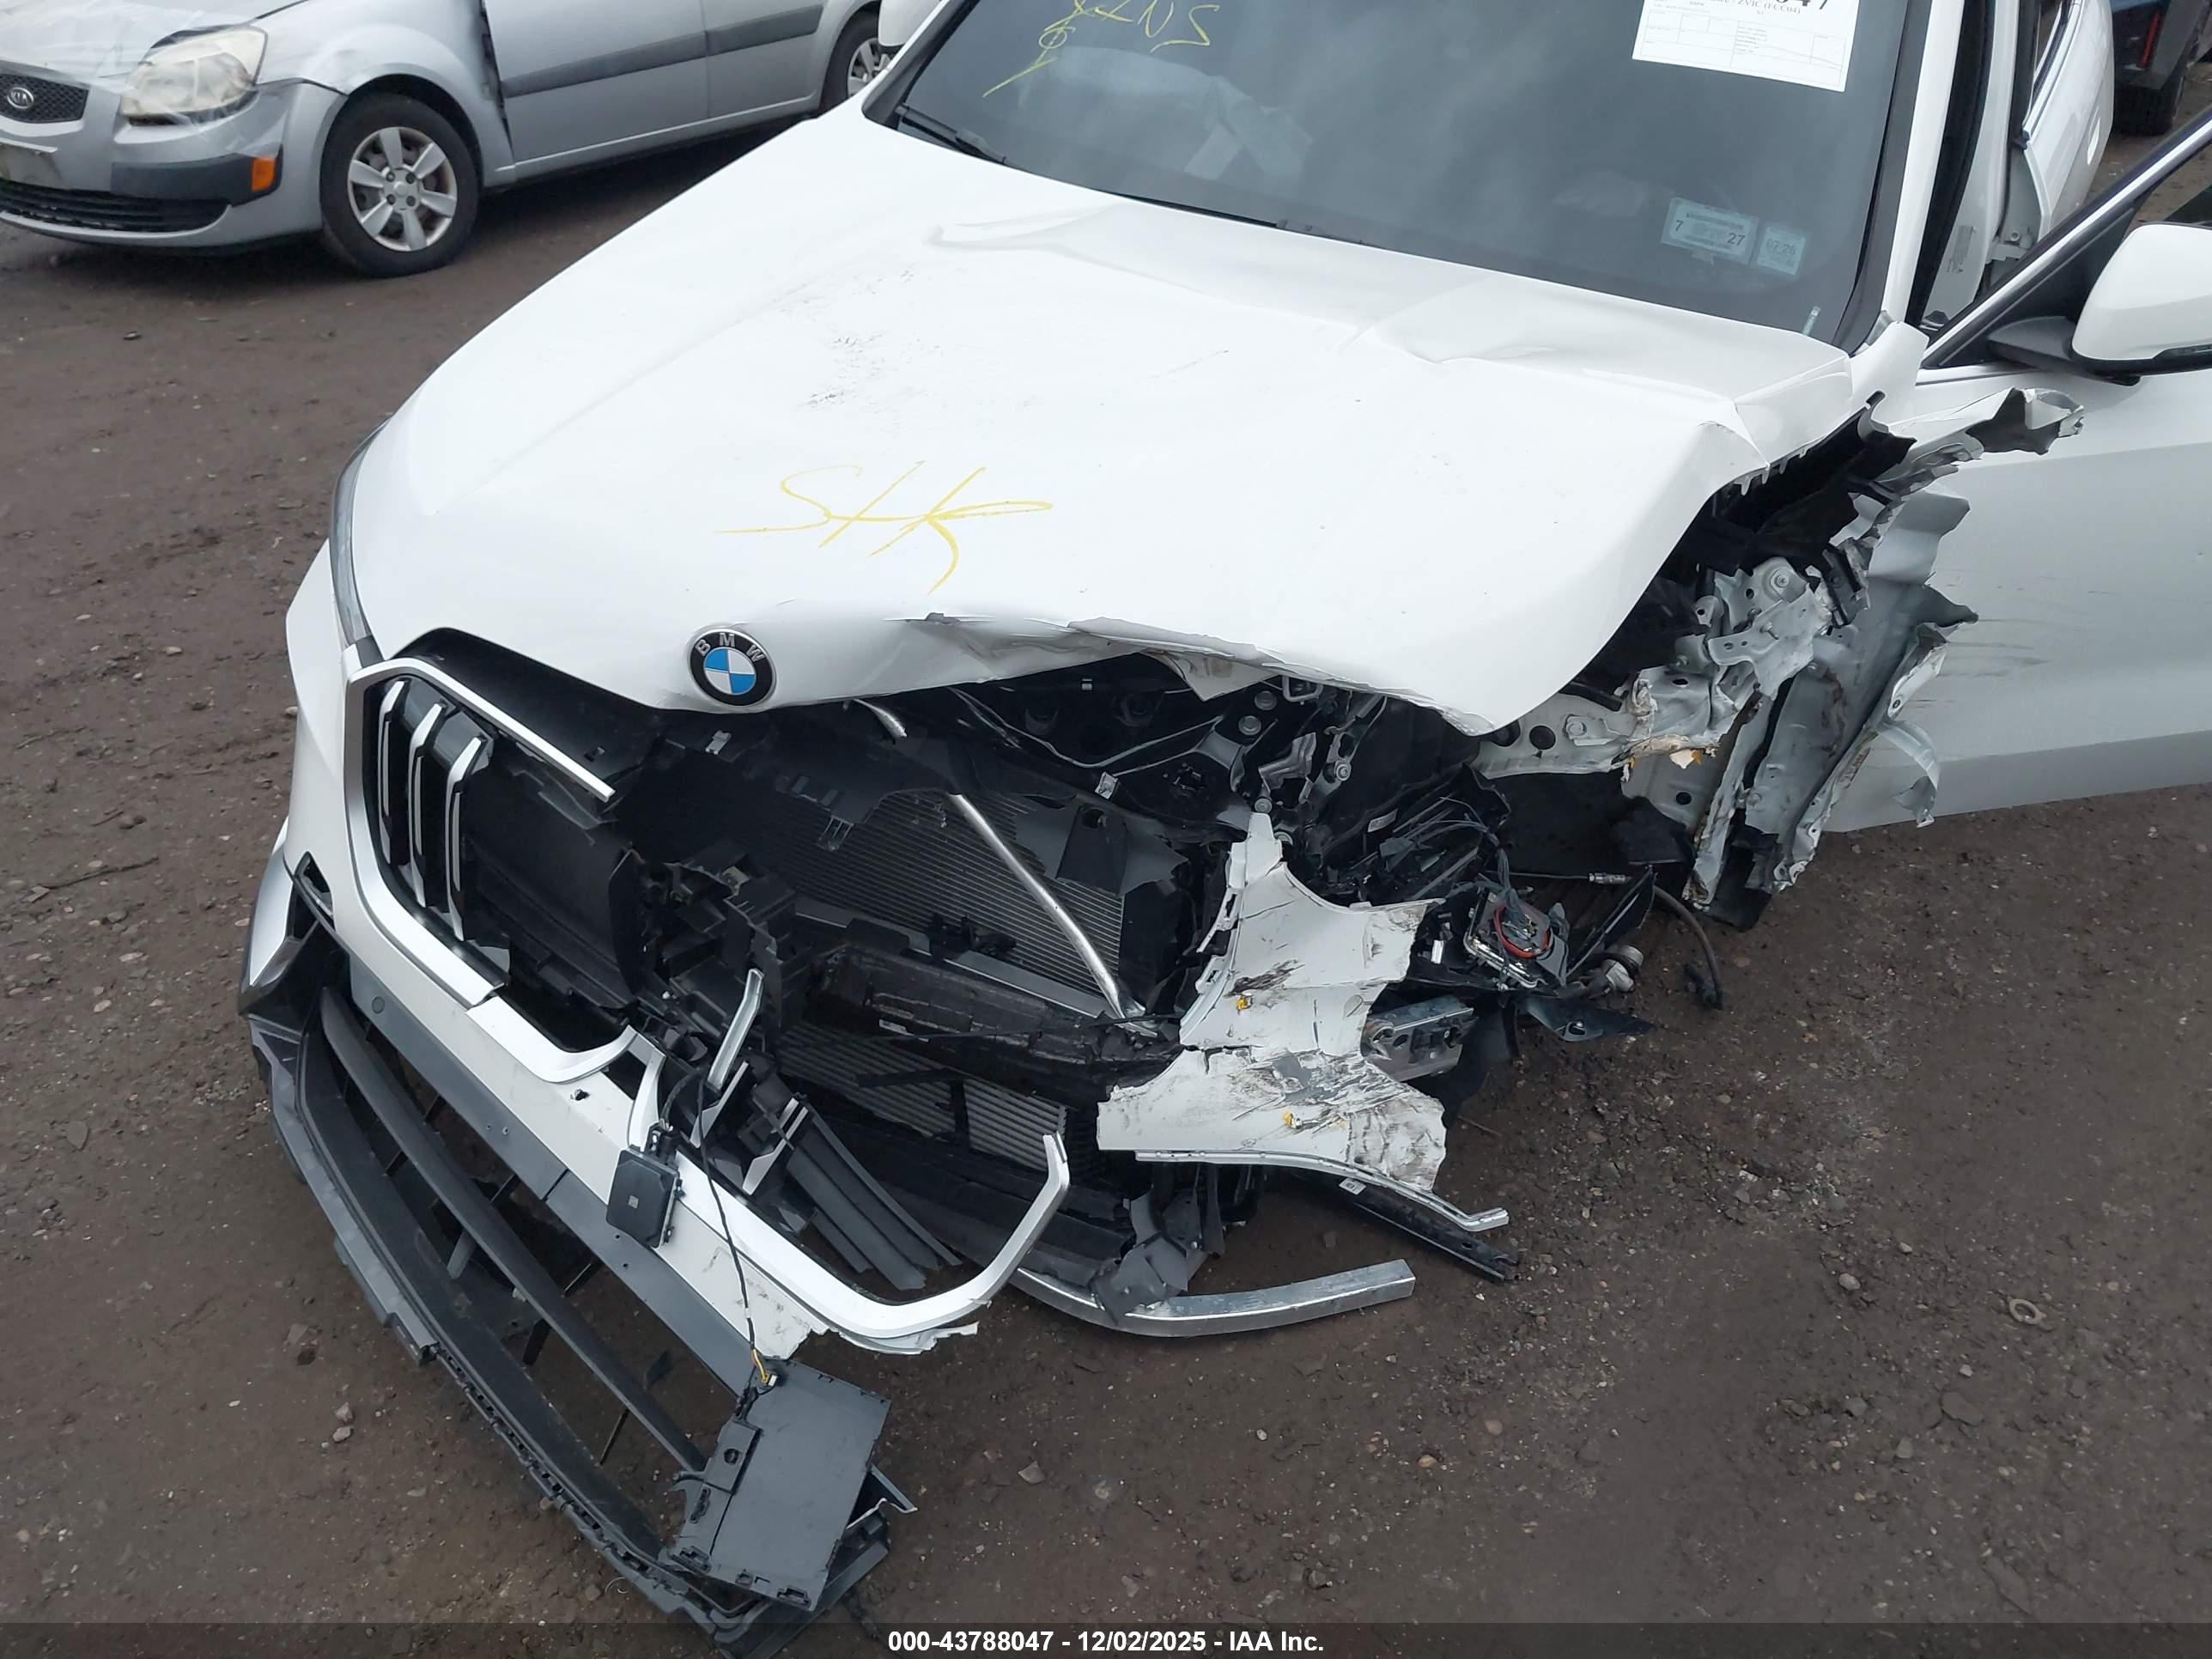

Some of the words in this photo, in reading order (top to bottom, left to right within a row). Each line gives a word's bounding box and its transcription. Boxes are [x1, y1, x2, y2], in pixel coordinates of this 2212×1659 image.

[1674, 219, 1684, 232] 7
[1727, 232, 1746, 246] 27
[695, 632, 766, 662] BMW
